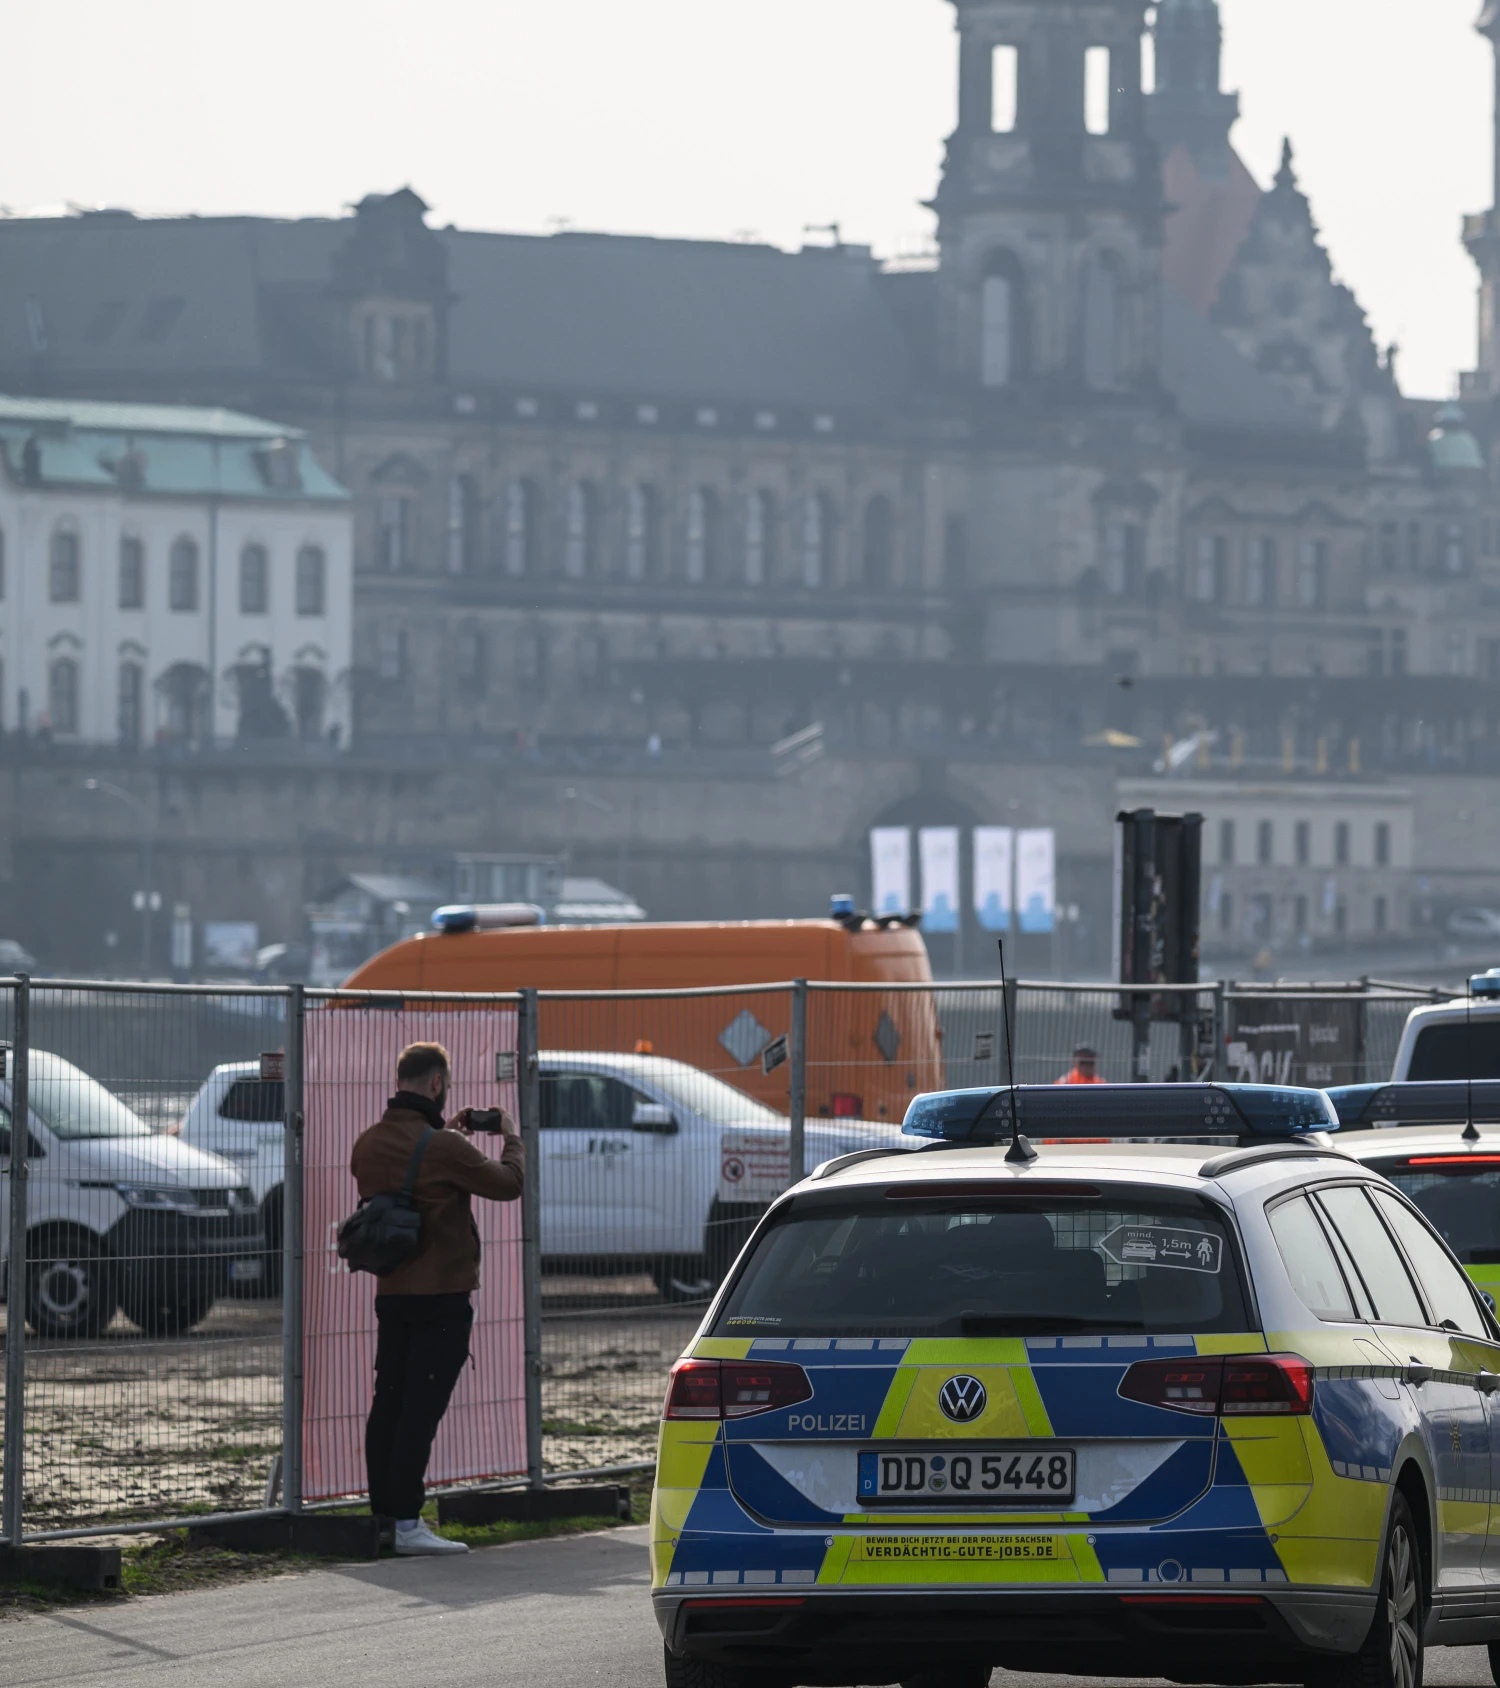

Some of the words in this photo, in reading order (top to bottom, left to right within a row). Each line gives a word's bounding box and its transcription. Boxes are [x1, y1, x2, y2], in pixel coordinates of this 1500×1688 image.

[1161, 1239, 1192, 1249] 1,5m
[788, 1414, 865, 1431] POLIZEI
[881, 1457, 926, 1491] DD
[950, 1456, 972, 1490] Q
[981, 1456, 1067, 1490] 5448
[866, 1536, 899, 1544] BEWIRB
[900, 1536, 920, 1544] DICH
[922, 1536, 945, 1545] JETZT
[947, 1536, 960, 1544] BEI
[962, 1536, 978, 1544] DER
[981, 1536, 1013, 1544] POLIZEI
[1015, 1536, 1052, 1544] SACHSEN
[866, 1545, 1053, 1559] VERDÄCHTIG-GUTE-JOBS.DE
